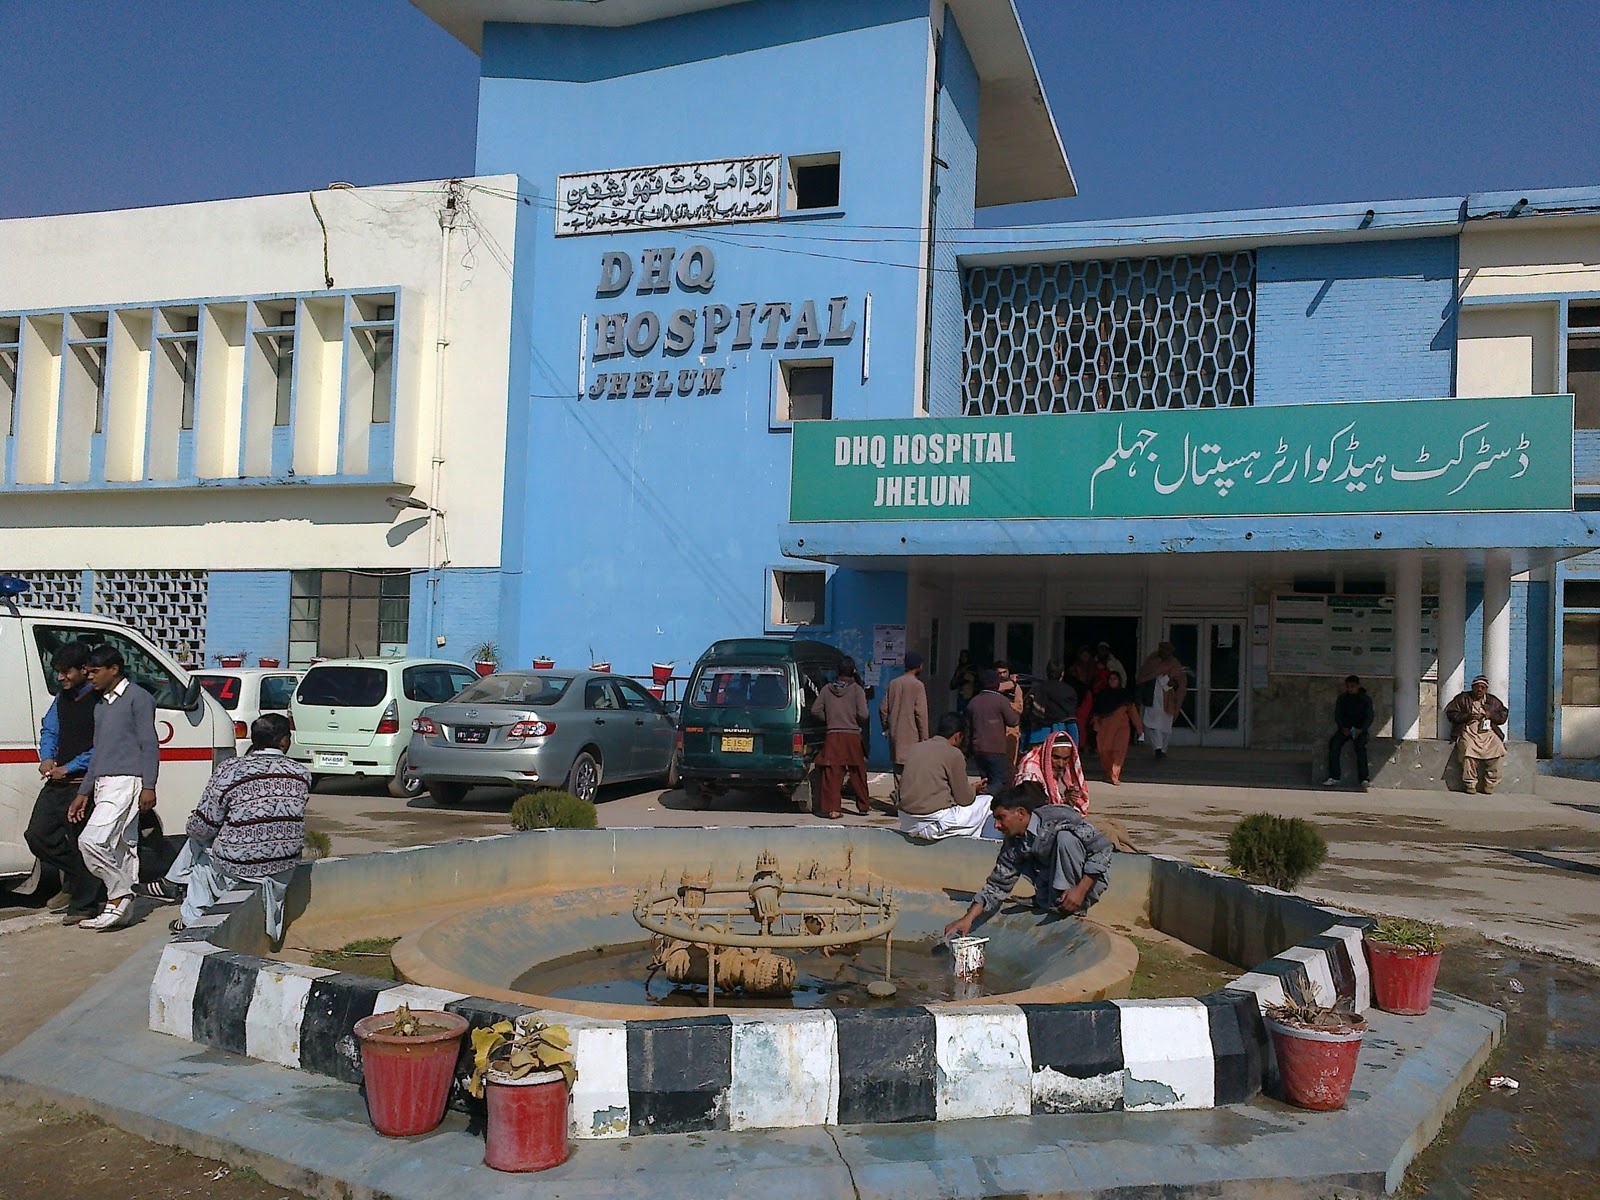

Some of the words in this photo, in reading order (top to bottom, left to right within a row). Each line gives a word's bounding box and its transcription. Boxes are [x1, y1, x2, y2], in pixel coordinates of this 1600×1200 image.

[595, 245, 716, 299] DHQ
[592, 297, 857, 362] HOSPITAL
[588, 368, 725, 401] JHELUM
[835, 436, 886, 468] DHQ
[893, 432, 1015, 465] HOSPITAL
[1090, 422, 1158, 511] جہلم
[1154, 432, 1261, 497] ہسپتال
[1391, 421, 1531, 496] ڈسٹرکٹ
[874, 475, 970, 507] JHELUM
